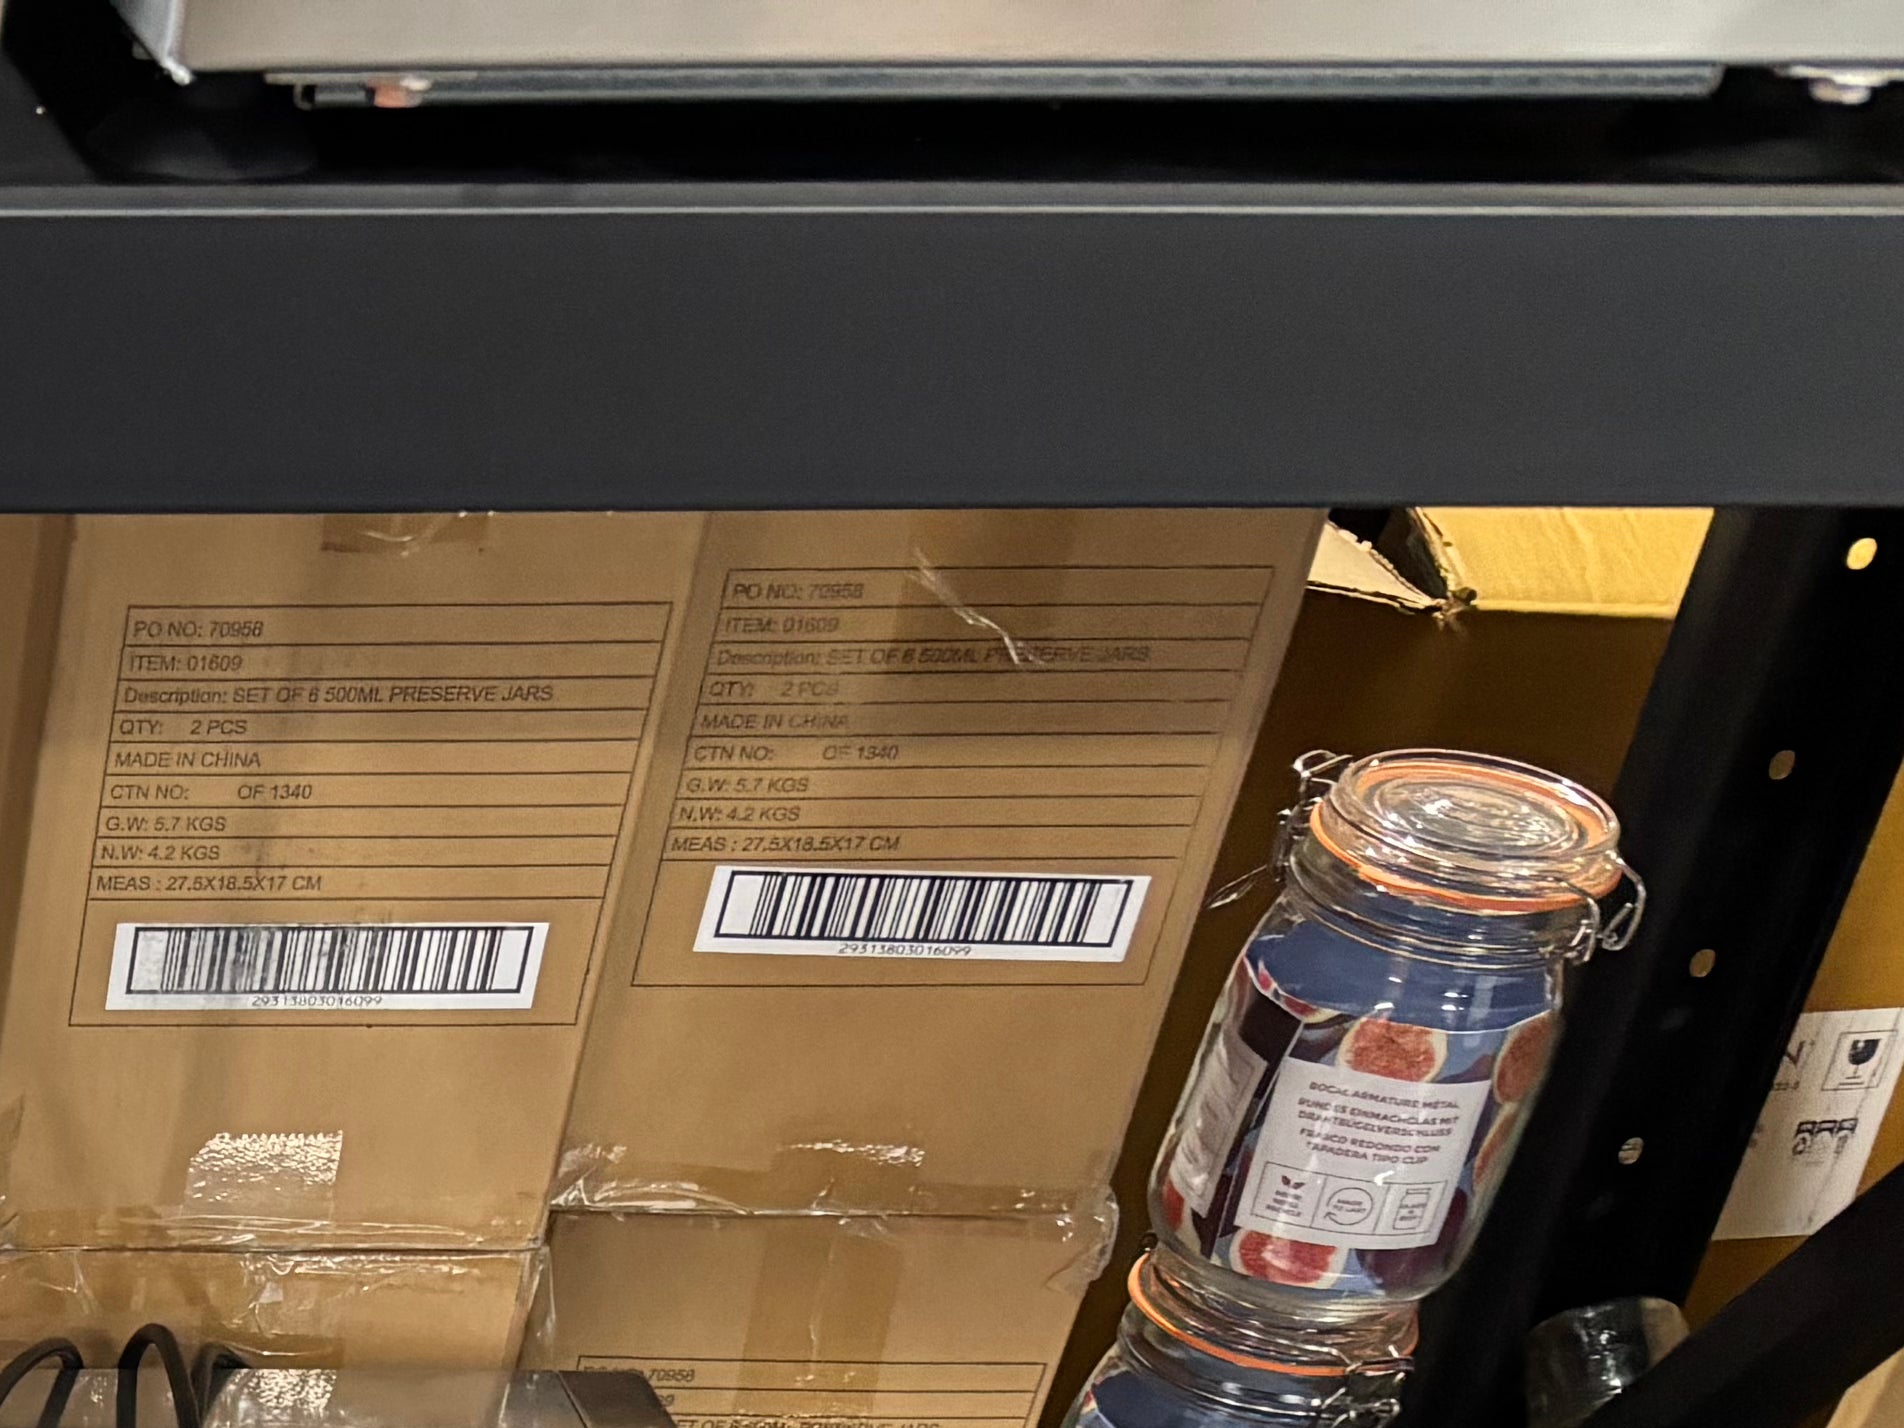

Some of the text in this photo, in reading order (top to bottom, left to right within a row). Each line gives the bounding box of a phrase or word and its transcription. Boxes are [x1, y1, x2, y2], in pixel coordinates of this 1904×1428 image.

[733, 584, 762, 600] PO
[767, 584, 802, 600] NO:
[133, 621, 263, 638] PO NO: 70958
[724, 617, 838, 634] ITEM: 01609
[129, 655, 242, 672] ITEM: 01609
[717, 649, 821, 667] Description:
[826, 650, 864, 665] SET
[869, 649, 898, 664] OF
[1096, 646, 1151, 662] JARS
[124, 686, 553, 705] Description: SET OF 6 500ML PRESERVE JARS
[710, 681, 753, 697] QTY:
[781, 681, 792, 696] 2
[120, 720, 247, 736] QTY: 2 PCS
[701, 713, 848, 729] MADE IN CHINA
[115, 752, 260, 768] MADE IN CHINA
[694, 745, 734, 760] CTN
[739, 745, 773, 760] NO:
[823, 745, 851, 760] OF
[110, 784, 312, 800] CTN NO: OF 1340
[687, 777, 809, 792] G.W: 5.7 KGS
[679, 806, 800, 822] N.W: 4.2 KGS
[105, 816, 226, 832] G.W: 5.7 KGS
[869, 836, 900, 852] CM
[101, 845, 220, 861] N.W: 4.2 KGS
[292, 875, 321, 891] CM
